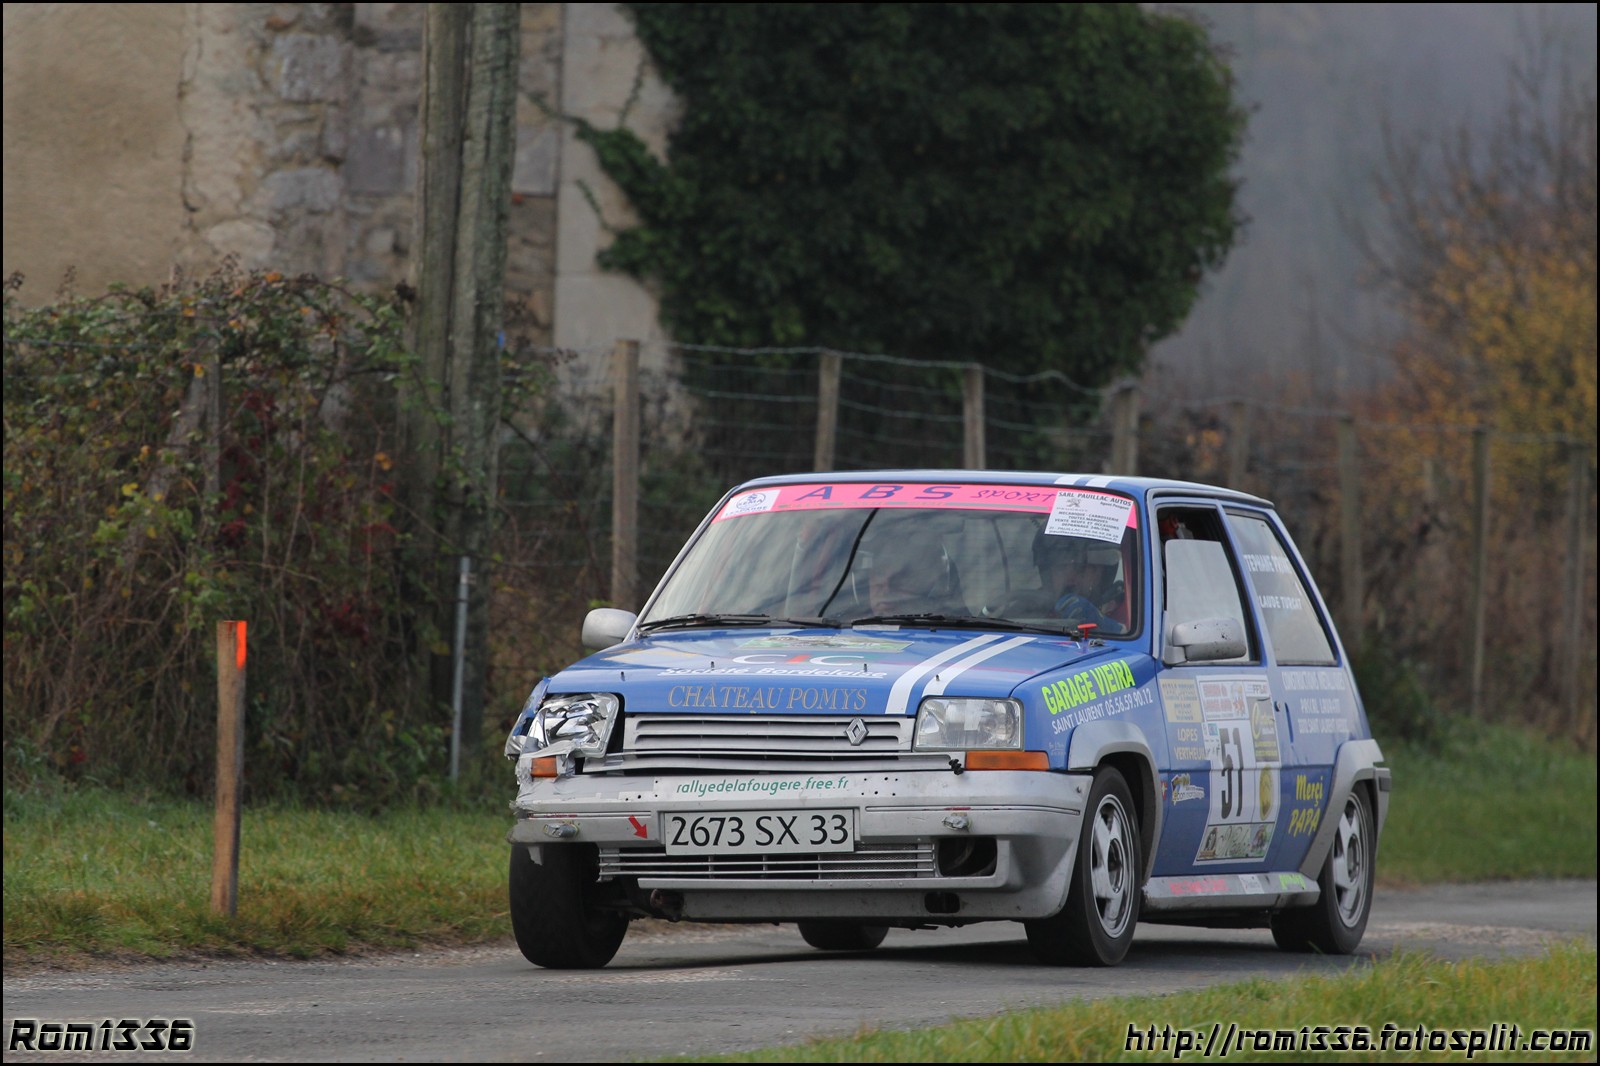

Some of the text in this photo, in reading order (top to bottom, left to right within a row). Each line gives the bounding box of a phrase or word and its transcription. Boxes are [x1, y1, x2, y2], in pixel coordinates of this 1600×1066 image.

[969, 489, 1056, 502] SPORT
[1077, 493, 1109, 502] PAUILLAC
[732, 654, 865, 666] CIC
[755, 667, 887, 678] Bordelaise
[1041, 671, 1097, 715] GARAGE
[1089, 659, 1136, 696] VIEIRA
[786, 687, 867, 710] POMYS
[1051, 711, 1075, 735] SAINT
[1074, 703, 1105, 725] LAURENT
[1104, 687, 1153, 716] 05.56.59.90.12
[1177, 727, 1198, 742] LOPES
[1219, 727, 1245, 819] 51
[677, 776, 849, 797] rallyedelafougere.free.fr
[670, 814, 849, 847] 2673 SX 33
[1288, 808, 1321, 837] PAPA
